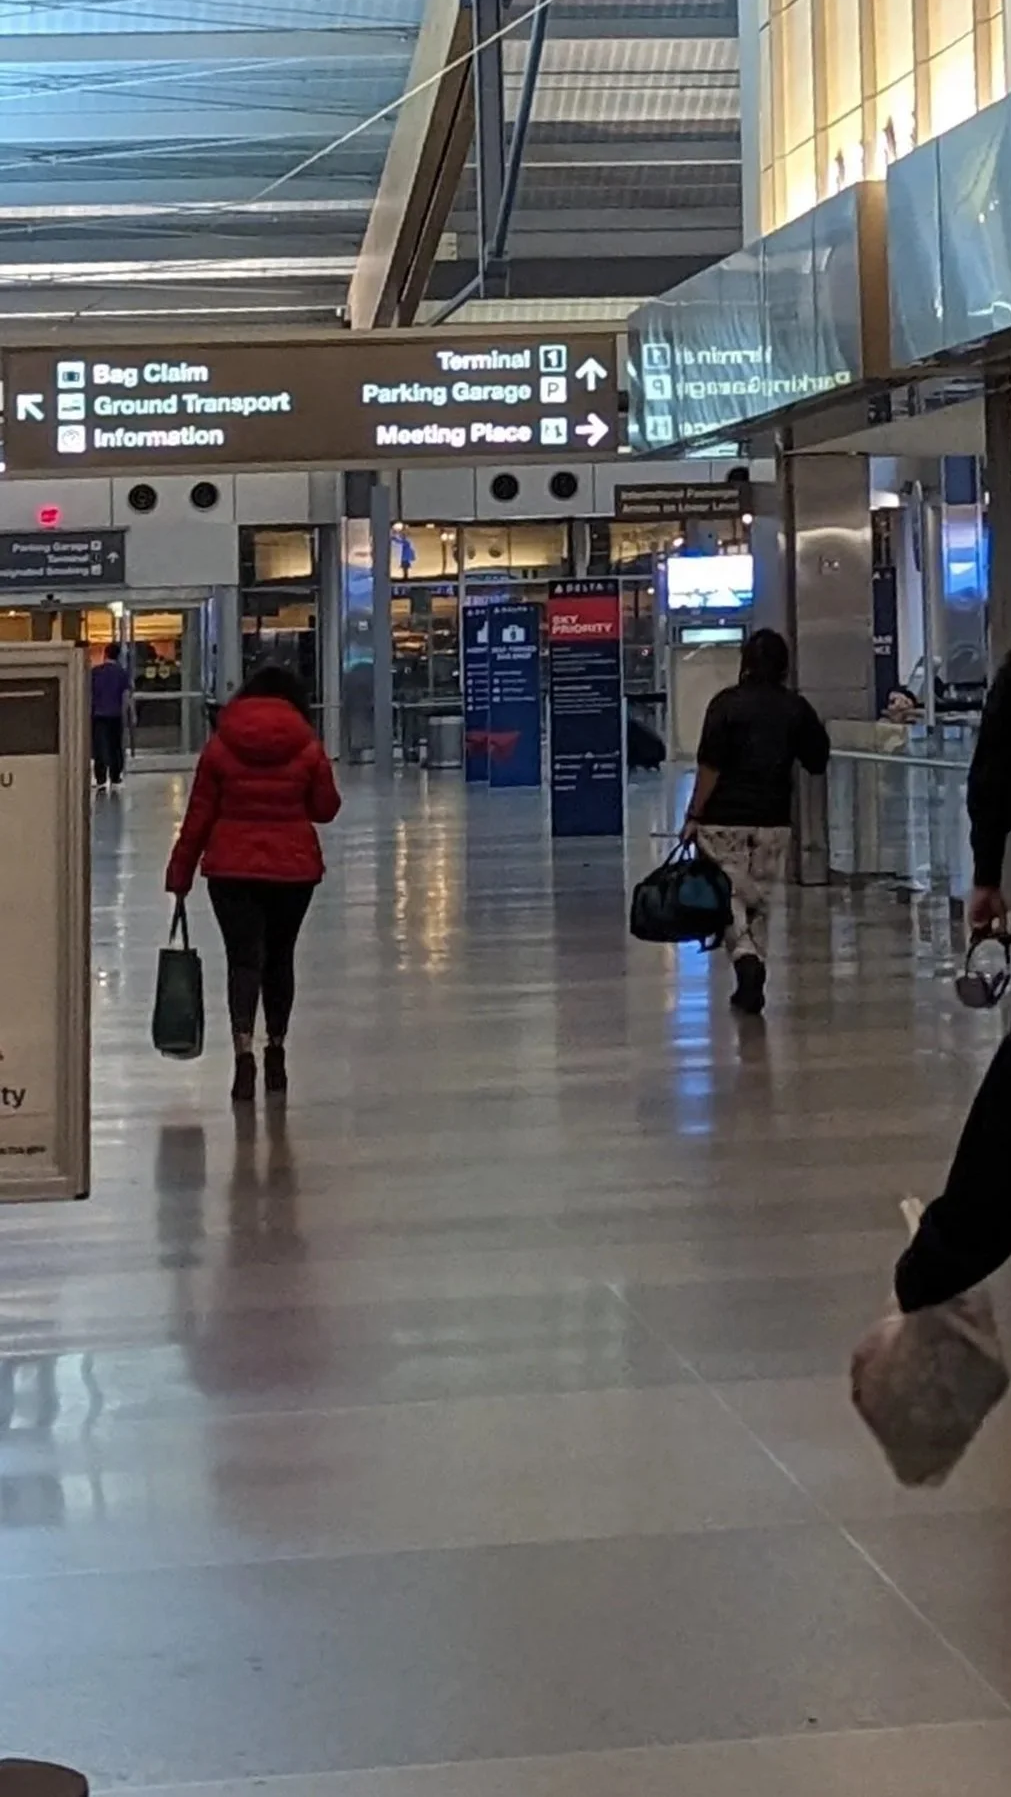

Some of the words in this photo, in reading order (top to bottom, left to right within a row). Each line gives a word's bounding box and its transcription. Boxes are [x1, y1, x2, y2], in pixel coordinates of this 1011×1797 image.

[437, 349, 531, 371] Terminal
[93, 364, 138, 388] Bag
[143, 362, 209, 383] Claim
[93, 393, 178, 415] Ground
[182, 391, 291, 416] Transport
[362, 383, 448, 406] Parking
[452, 381, 532, 404] Garage
[93, 425, 224, 448] Information
[376, 424, 467, 448] Meeting
[470, 422, 532, 443] Place
[552, 614, 579, 624] SKY
[552, 622, 613, 635] PRIORITY
